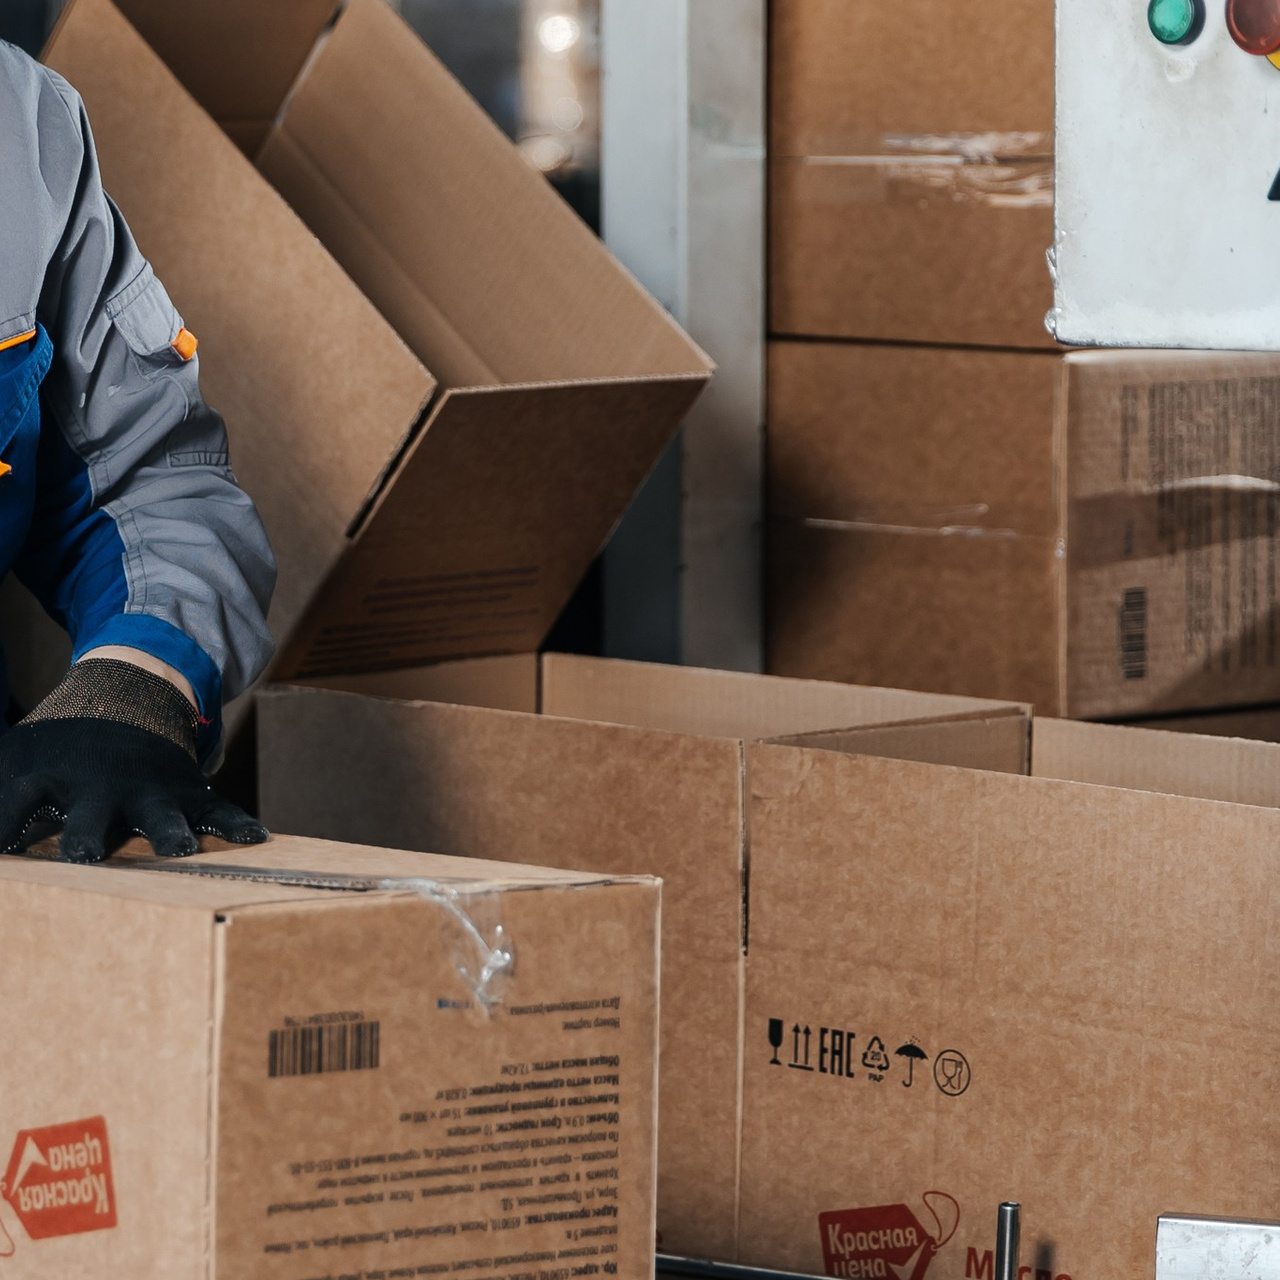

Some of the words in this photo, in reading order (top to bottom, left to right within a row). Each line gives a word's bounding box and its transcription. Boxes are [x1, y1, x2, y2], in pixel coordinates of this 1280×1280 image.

[593, 1074, 619, 1086] Масса
[567, 1093, 619, 1106] Количество
[48, 1132, 103, 1172] цена
[18, 1167, 109, 1214] Красная
[591, 1204, 618, 1218] Адрес
[827, 1223, 919, 1259] Красная
[834, 1257, 887, 1280] цена
